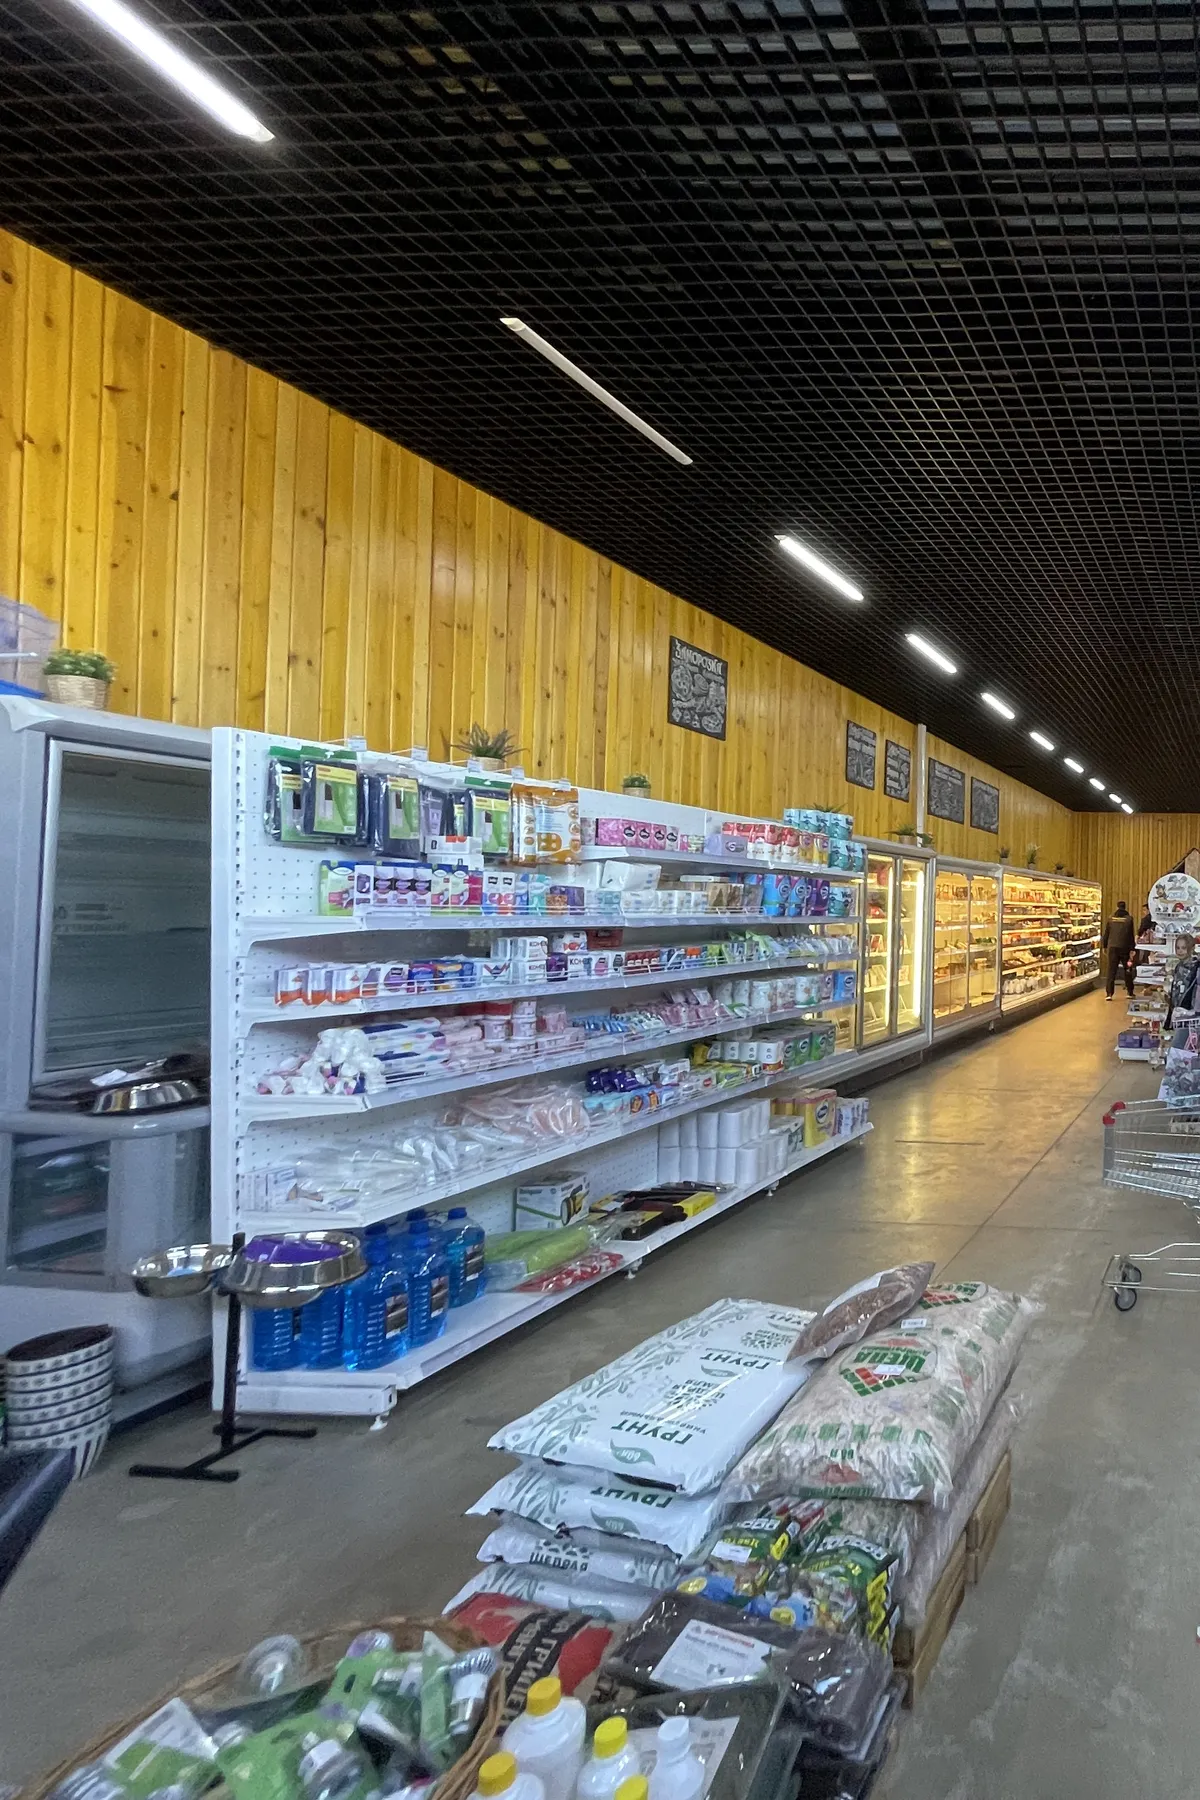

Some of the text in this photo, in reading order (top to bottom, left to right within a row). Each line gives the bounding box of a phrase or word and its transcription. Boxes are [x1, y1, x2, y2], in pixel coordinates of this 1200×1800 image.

[674, 642, 722, 675] ЗАМОРОЗКА
[700, 1352, 771, 1370] ГРУНТ
[853, 1351, 927, 1374] ЩЕПА
[610, 1419, 694, 1445] ГРУНТ
